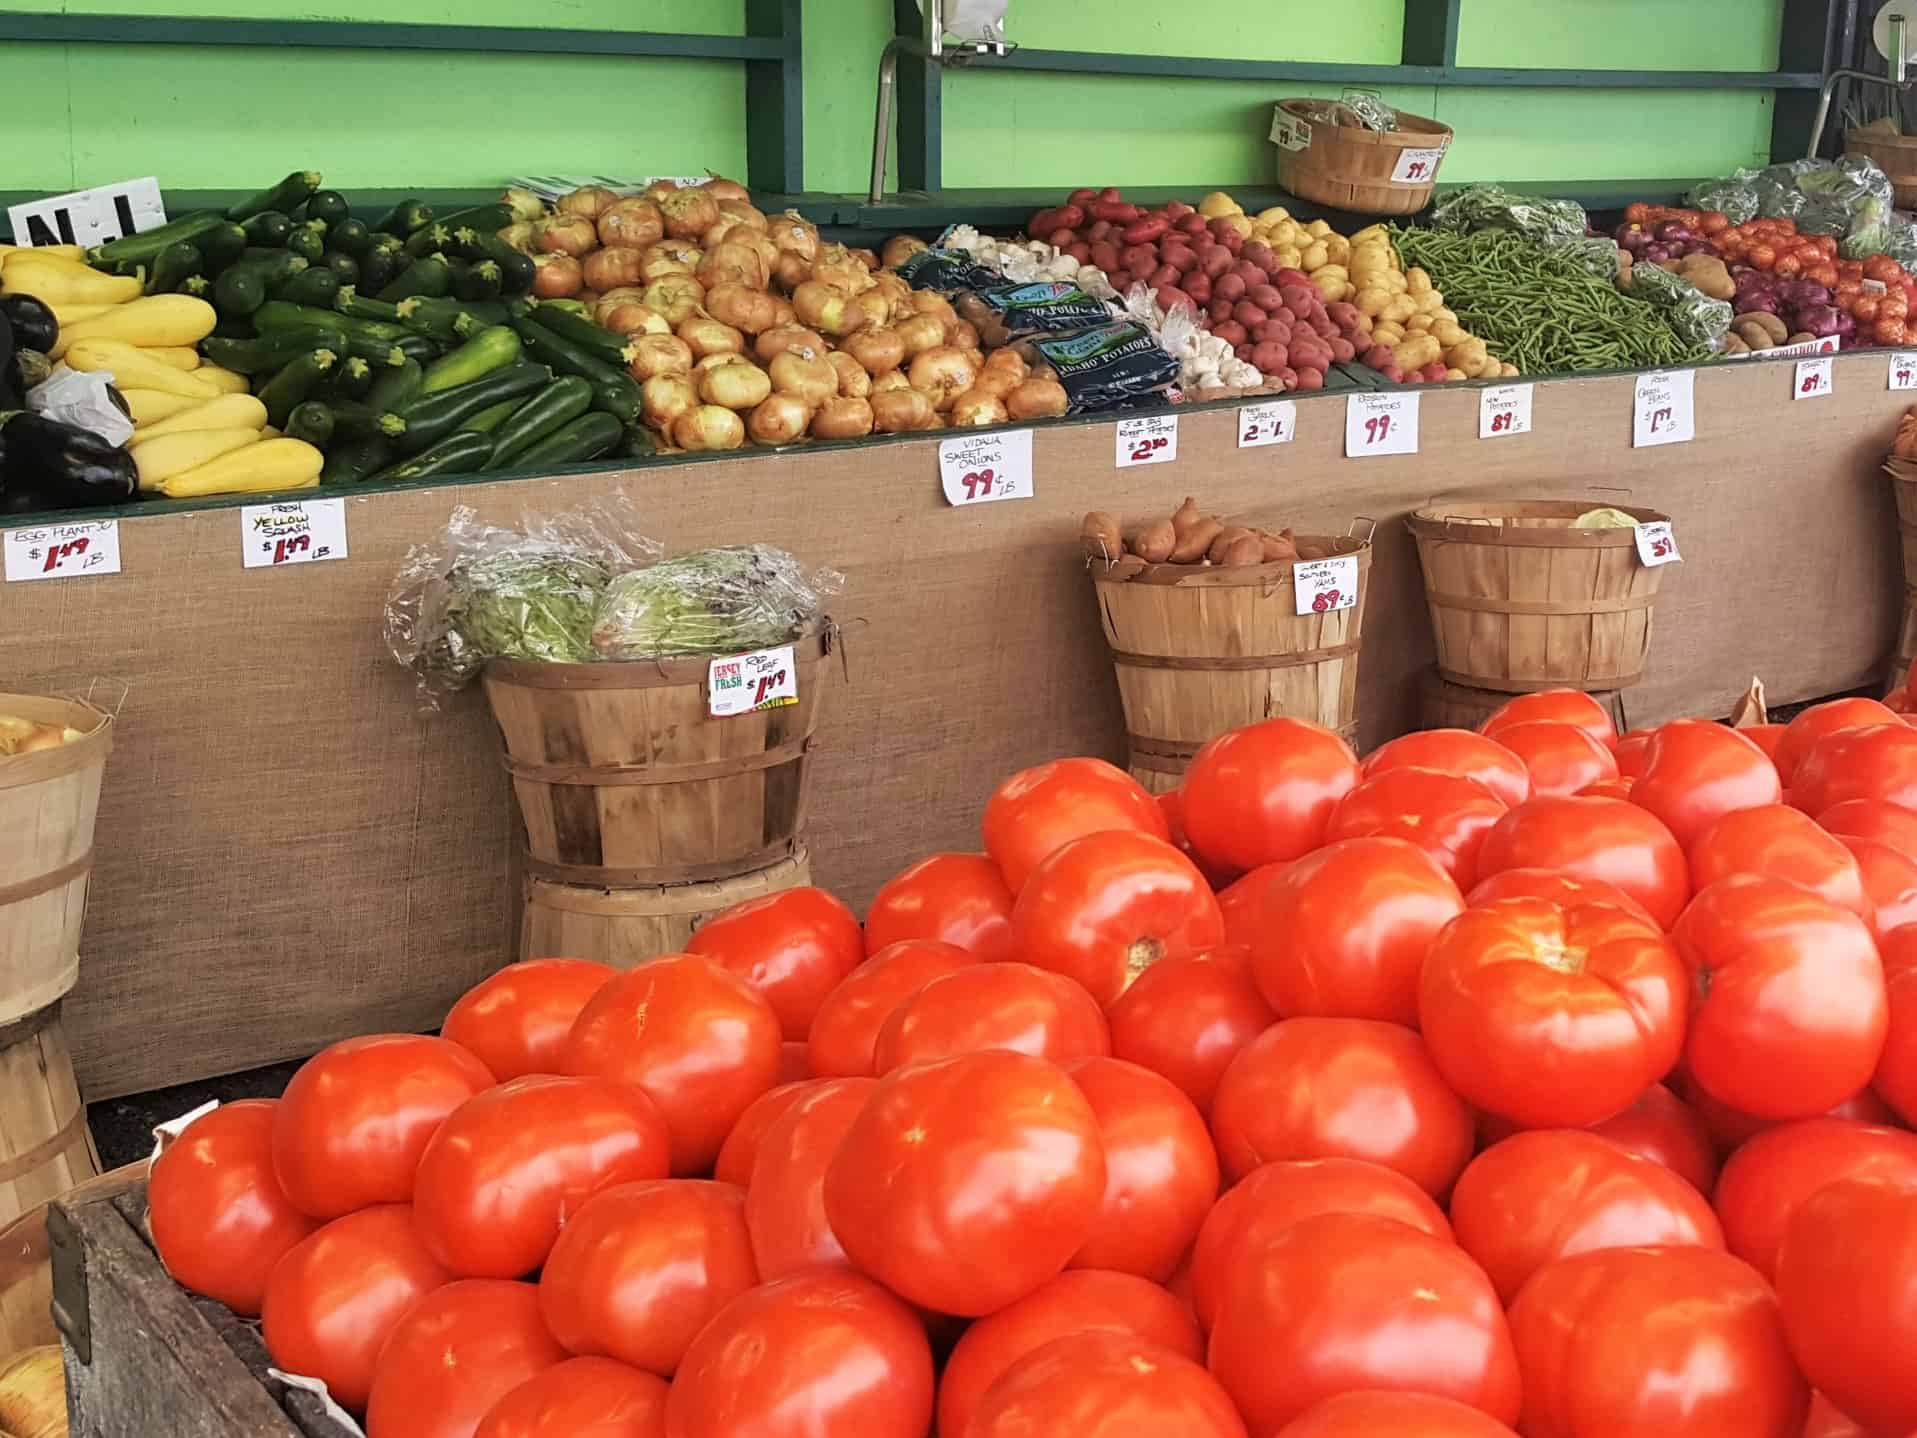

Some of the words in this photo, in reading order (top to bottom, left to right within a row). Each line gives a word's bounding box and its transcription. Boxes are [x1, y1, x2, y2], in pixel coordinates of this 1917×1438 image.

[944, 448, 984, 463] SWEET
[254, 514, 309, 531] YELLOW
[15, 530, 48, 542] EGG
[714, 662, 741, 679] JERSEY
[715, 675, 742, 691] FRESH
